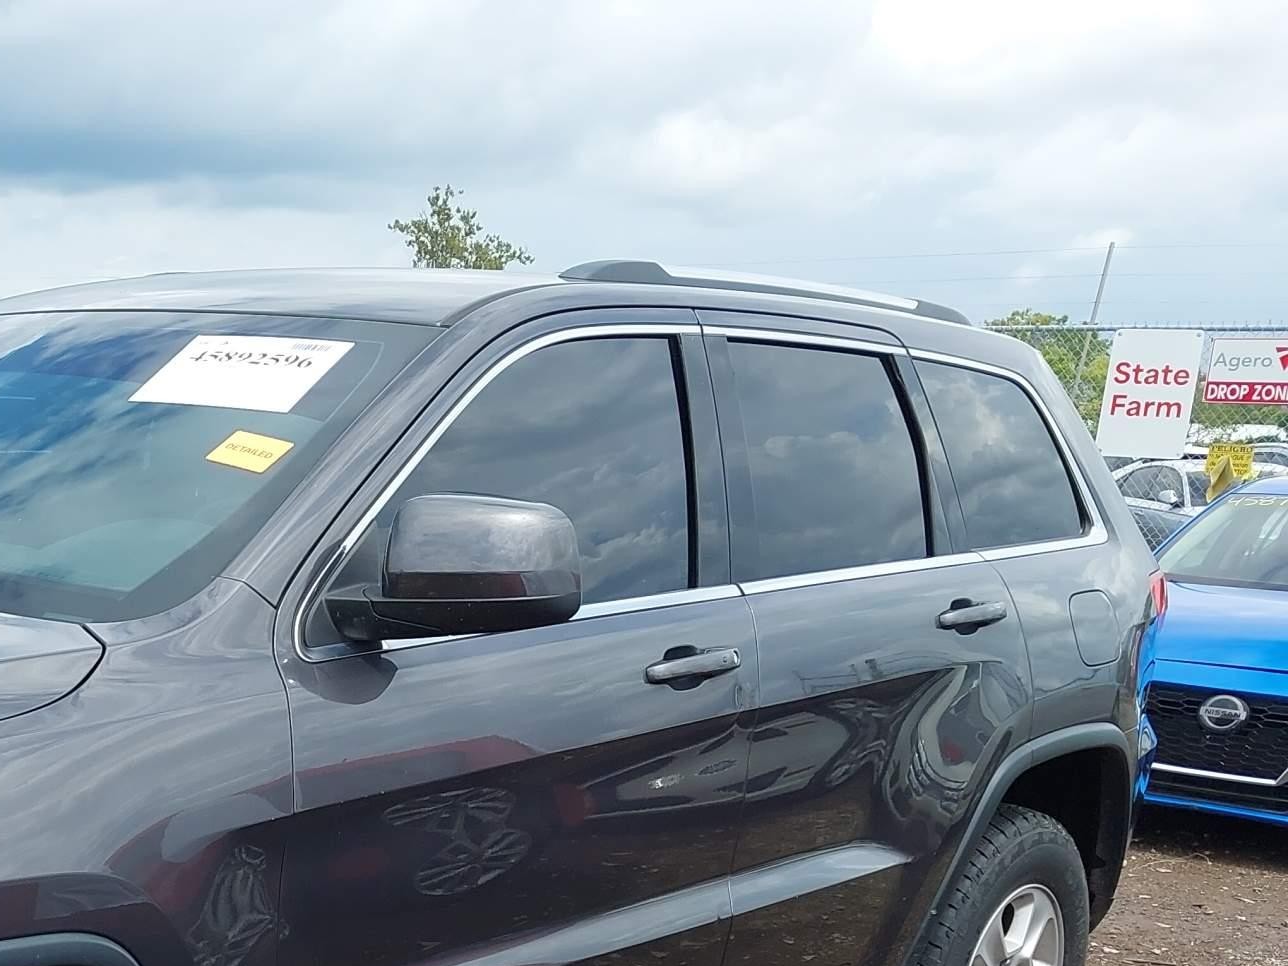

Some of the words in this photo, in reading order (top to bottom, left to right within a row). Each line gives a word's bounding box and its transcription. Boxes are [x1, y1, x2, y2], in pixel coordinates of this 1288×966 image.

[190, 350, 313, 368] 45892596
[1213, 353, 1273, 371] Agero
[1114, 362, 1190, 385] State
[1207, 384, 1250, 400] DROP
[1252, 385, 1288, 401] ZON
[1110, 395, 1182, 418] Farm
[225, 443, 273, 459] DETAILED
